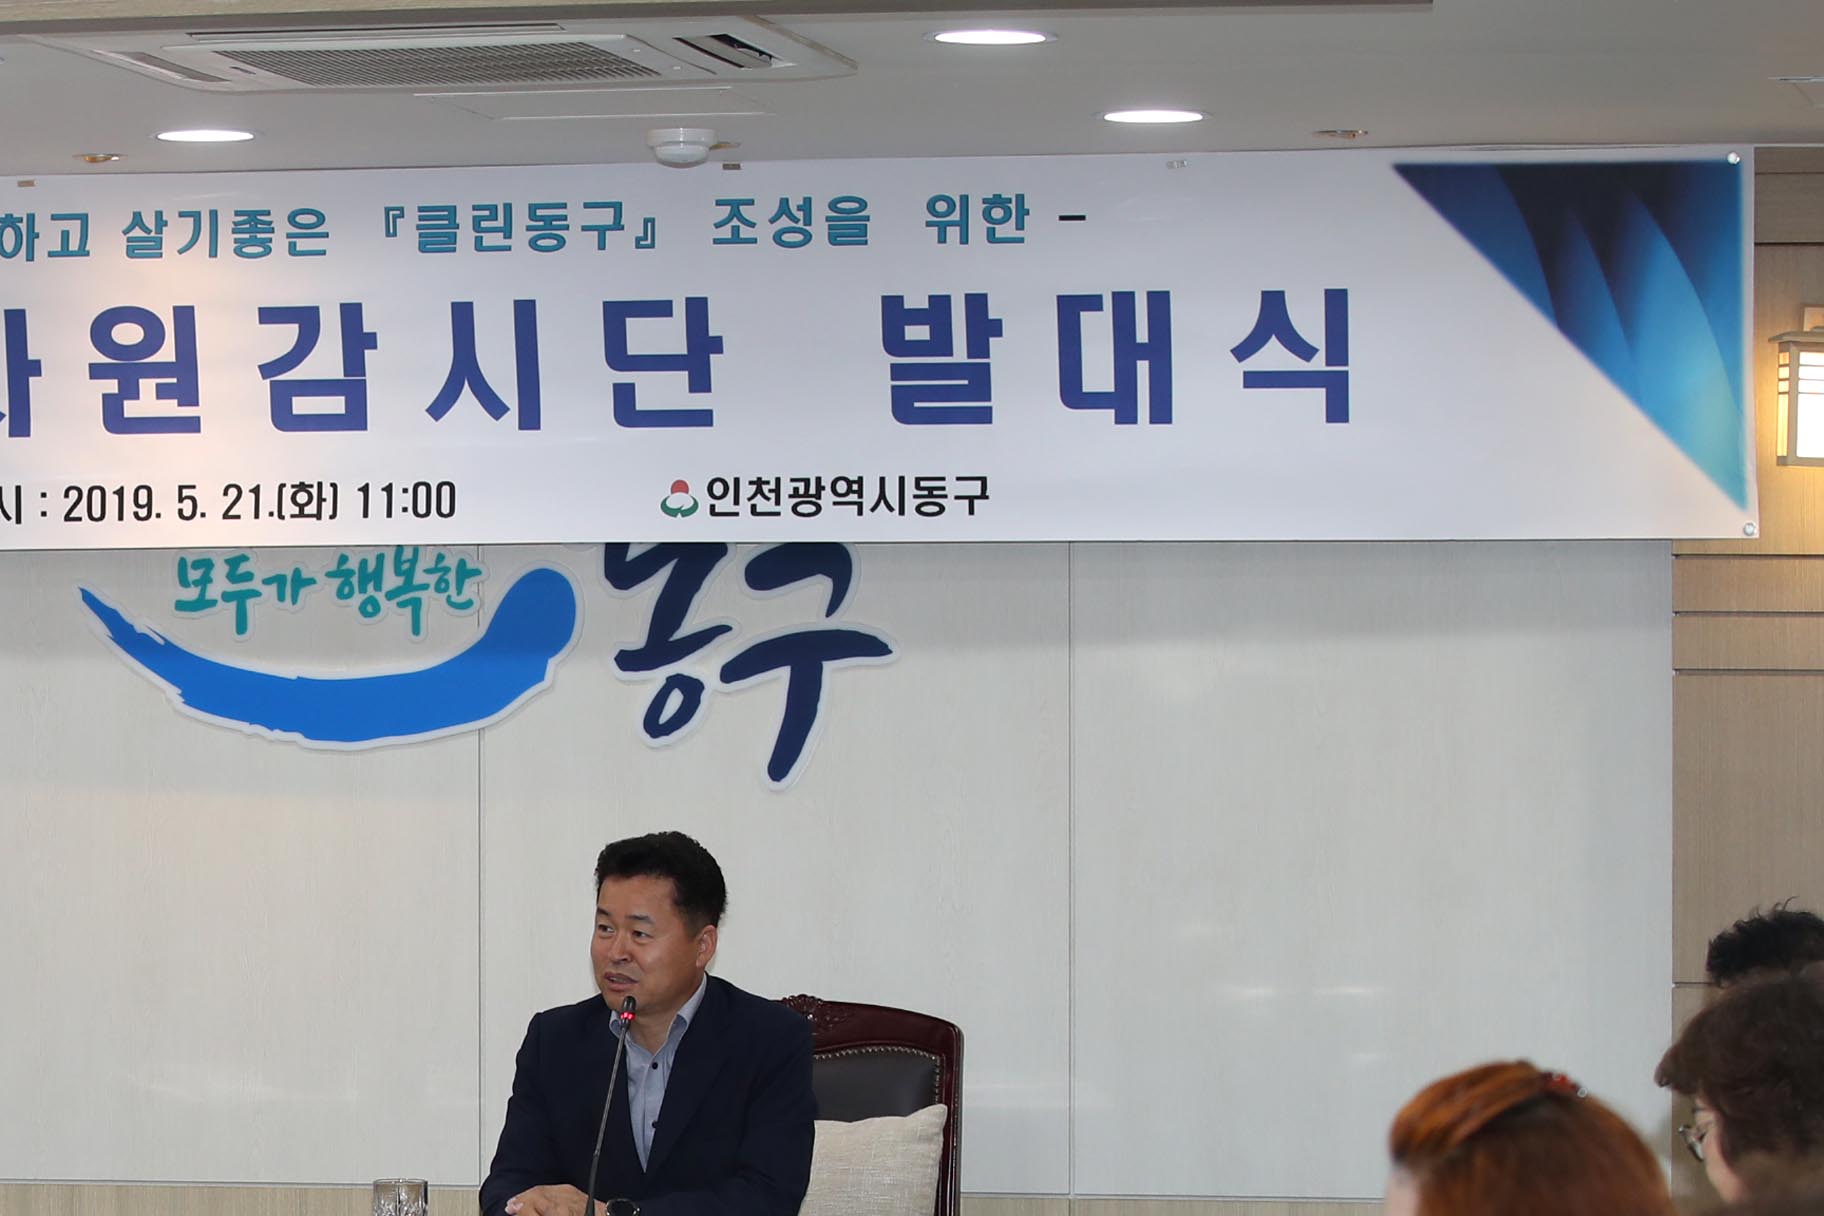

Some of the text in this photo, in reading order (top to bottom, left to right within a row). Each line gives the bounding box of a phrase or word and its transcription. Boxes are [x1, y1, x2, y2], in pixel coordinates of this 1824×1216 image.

[122, 208, 331, 261] 살기좋은
[713, 196, 872, 250] 조성을
[925, 193, 1032, 247] 위한
[881, 288, 1351, 427] 발대식
[64, 485, 163, 524] 2019.
[178, 485, 209, 523] 5.
[357, 481, 457, 520] 11:00
[707, 475, 991, 520] 인천광역시동구
[174, 545, 483, 637] 모두가 행복한
